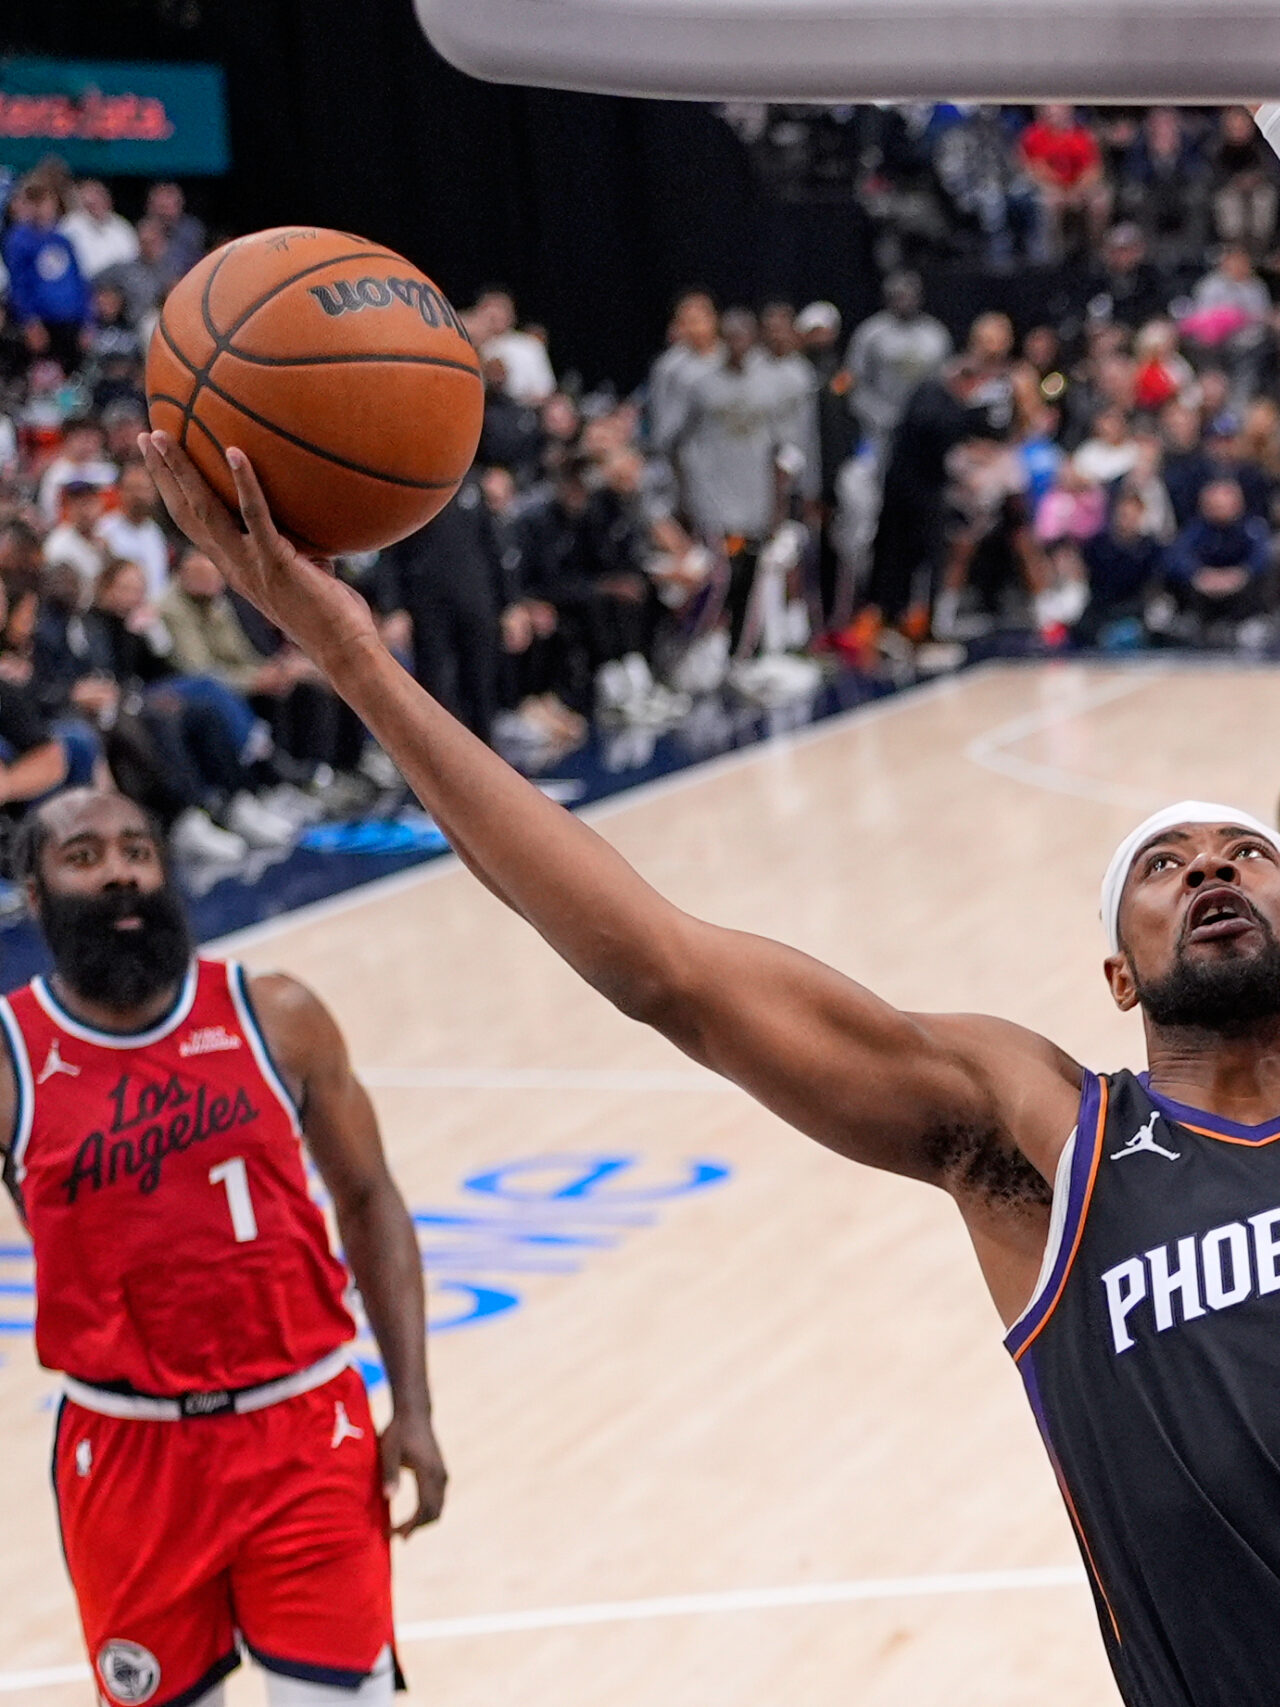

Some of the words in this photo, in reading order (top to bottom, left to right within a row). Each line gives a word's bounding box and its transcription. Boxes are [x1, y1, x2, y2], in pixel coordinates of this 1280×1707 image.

[62, 1085, 260, 1204] Angeles
[108, 1073, 191, 1134] Los
[209, 1155, 259, 1243] 1
